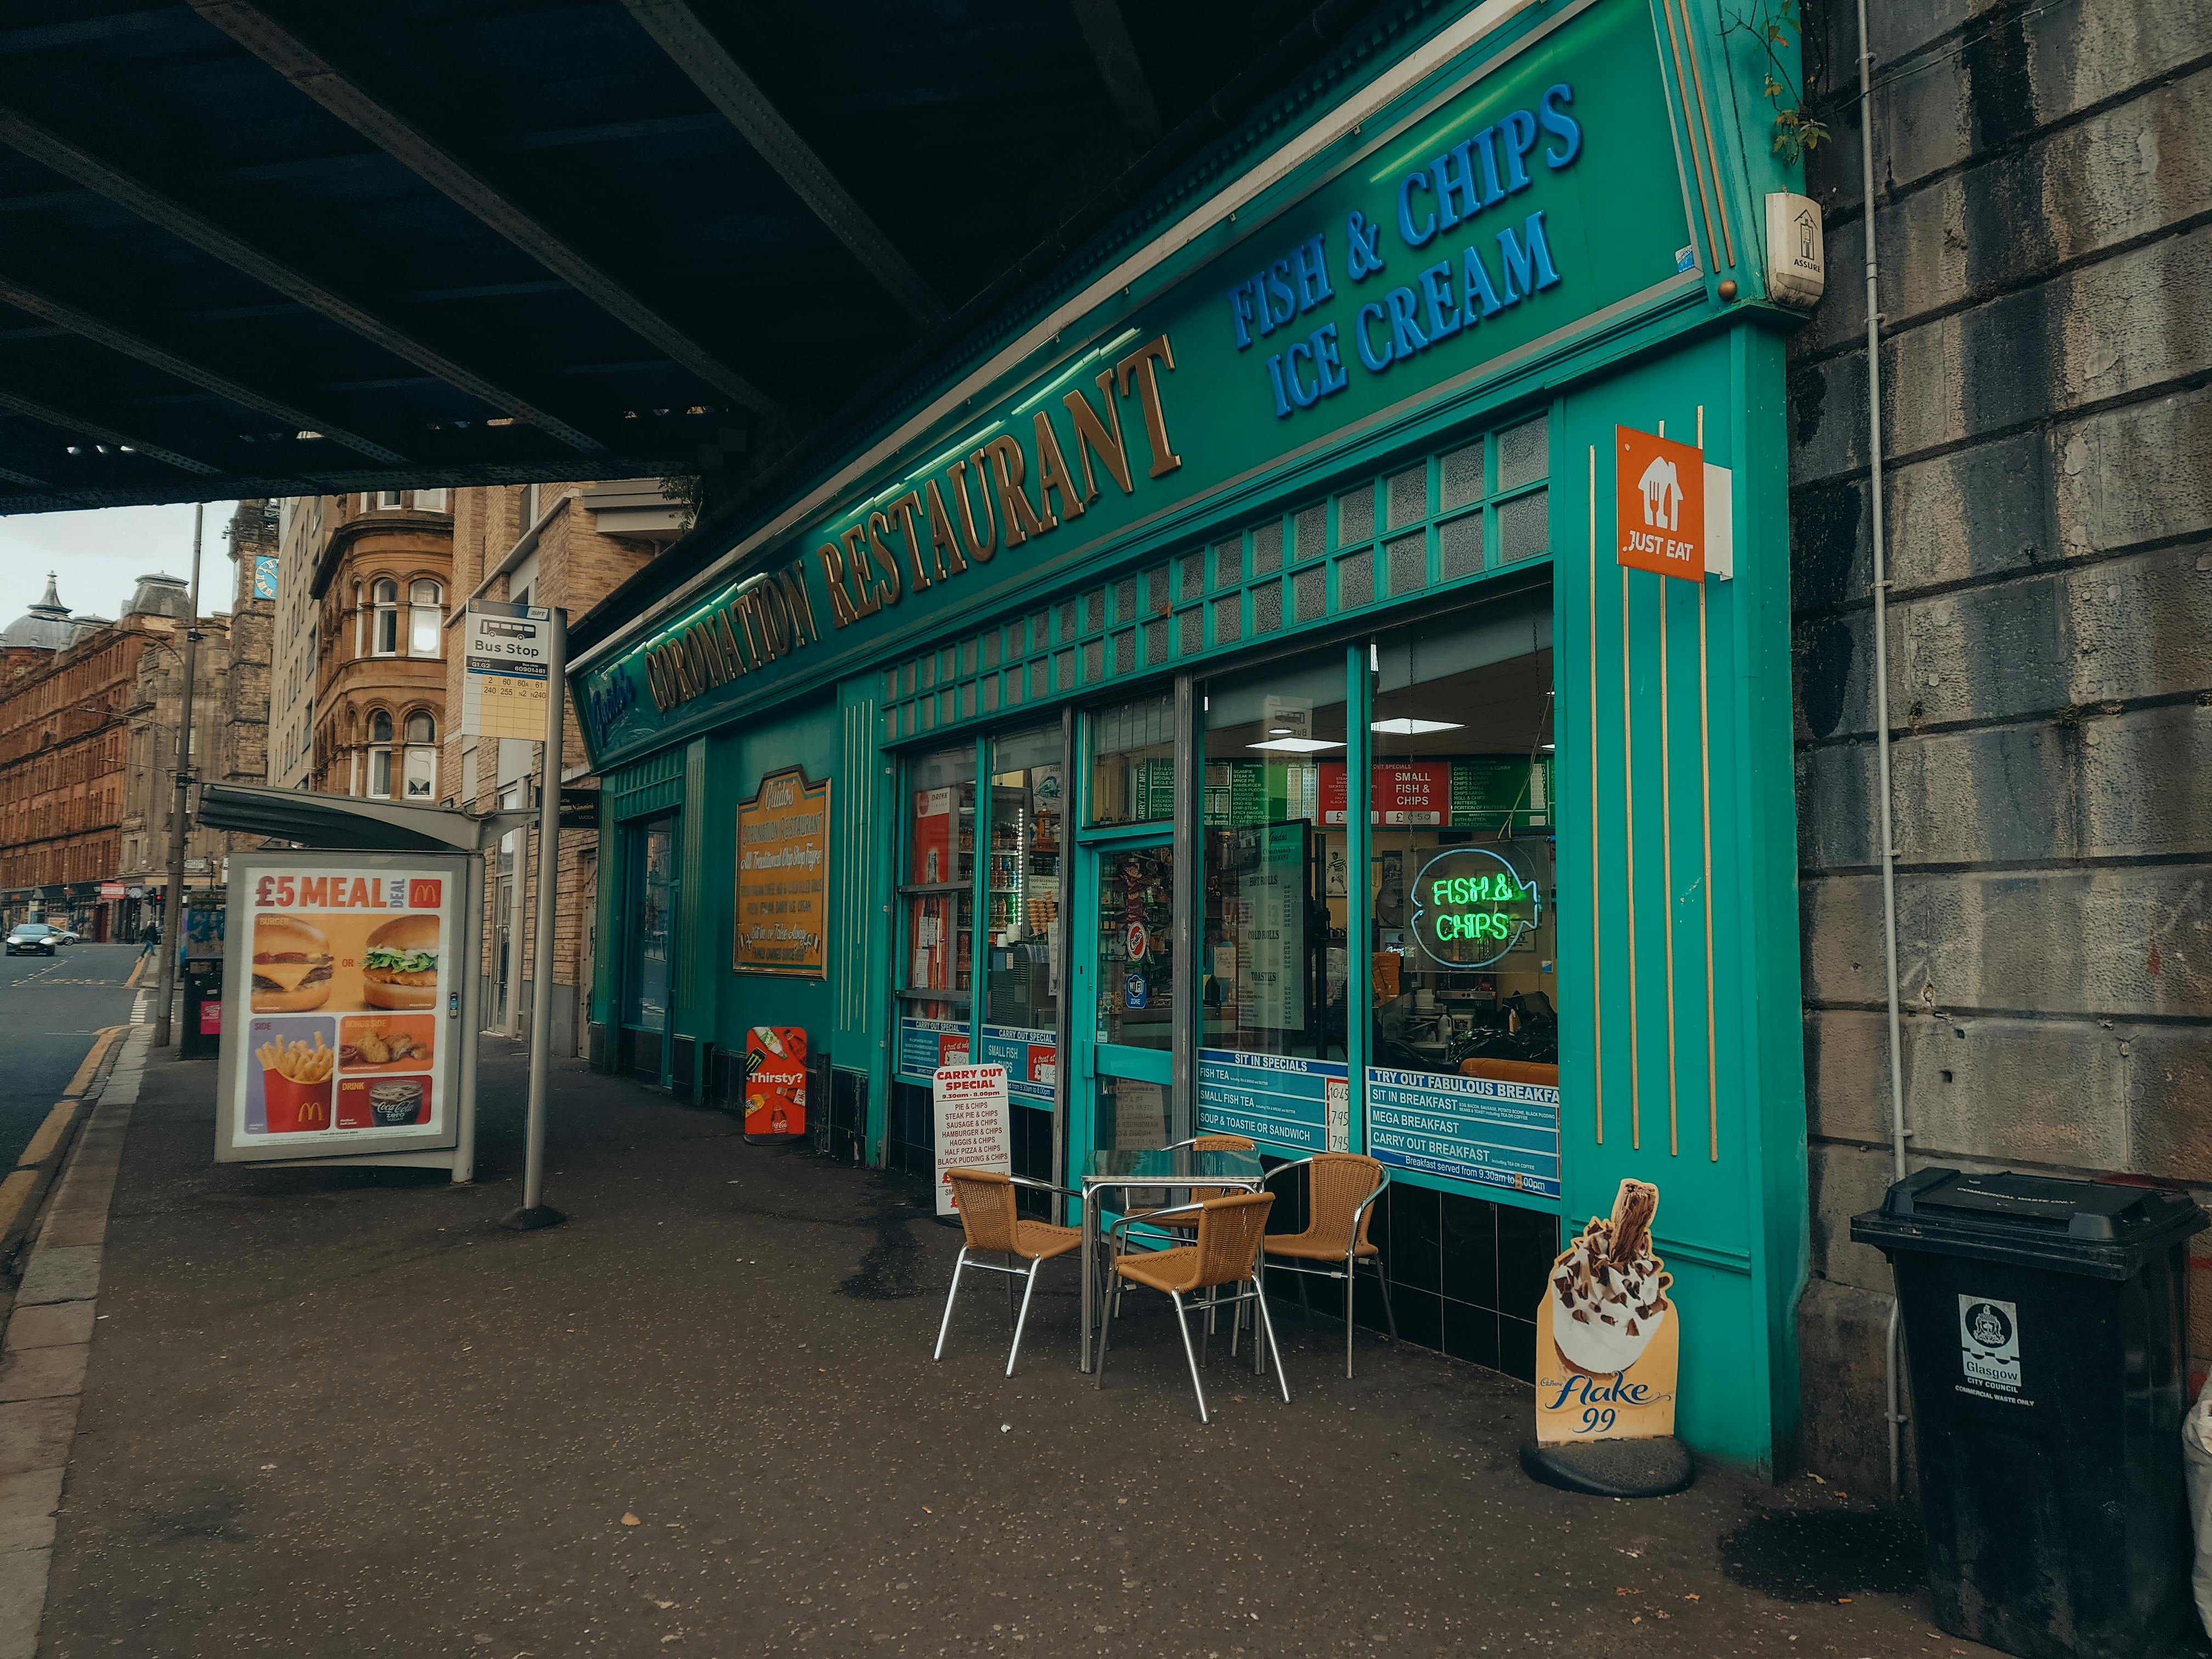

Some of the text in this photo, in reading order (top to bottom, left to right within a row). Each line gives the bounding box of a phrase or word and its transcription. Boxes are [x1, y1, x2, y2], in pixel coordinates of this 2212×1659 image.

[1228, 83, 1581, 349] FISH & CHIPS
[1793, 258, 1821, 273] ASSURE
[1266, 210, 1561, 417] ICE CREAM
[645, 334, 1181, 713] CORONATION RESTAURANT
[1623, 530, 1694, 561] JUST EAT
[475, 640, 539, 658] Bus Stop
[1395, 772, 1431, 781] SMALL
[932, 792, 948, 800] DRINK
[1396, 784, 1430, 793] FISH &
[1396, 797, 1429, 805] CHIPS
[742, 811, 822, 848] CORONATION RESTAURANT
[741, 851, 751, 870] All
[753, 848, 781, 869] Traditional
[1249, 876, 1278, 886] HOT ROLLS
[255, 876, 405, 909] £5 MEAL DEAL
[1434, 873, 1513, 905] FISH &
[259, 917, 289, 926] BURGER
[1436, 913, 1509, 941] CHIPS
[1248, 930, 1279, 940] COLD ROLLS
[342, 958, 354, 967] OR
[1251, 972, 1276, 981] TOASTIES
[255, 1022, 271, 1030] SIDE
[345, 1019, 386, 1028] BONUS SIDE
[940, 1023, 959, 1032] SPECIAL
[998, 1029, 1053, 1043] CARRY OUT SPECIAL
[988, 1045, 1018, 1059] SMALL FISH
[1235, 1053, 1307, 1073] SIT IN SPECIALS
[749, 1072, 803, 1085] Thirsty?
[936, 1068, 1003, 1080] CARRY OUT
[1200, 1068, 1229, 1080] FISH TEA
[341, 1081, 365, 1091] DRINK
[945, 1080, 995, 1091] SPECIAL
[1020, 1084, 1050, 1096] 9.30am 8.00pm
[1375, 1070, 1397, 1084] TRY
[1400, 1073, 1425, 1087] OUT
[1428, 1076, 1493, 1096] FABULOUS
[1200, 1090, 1254, 1108] SMALL FISH TEA
[1373, 1088, 1458, 1111] SIT IN BREAKFAST
[946, 1121, 974, 1129] SAUSAGE
[1200, 1112, 1310, 1142] SOUP & TOASTIE OR SANDWICH
[1373, 1110, 1459, 1134] MEGA BREAKFAST
[942, 1130, 979, 1138] HAMBURGER
[1373, 1132, 1489, 1163] CARRY OUT BREAKFAST
[938, 1157, 957, 1165] BLACK
[1406, 1155, 1436, 1170] Breakfast
[1437, 1163, 1460, 1174] served
[1461, 1166, 1478, 1177] from
[1479, 1170, 1506, 1183] 9.30am
[1507, 1173, 1515, 1184] to
[1967, 1361, 2017, 1380] Glasgow
[1545, 1370, 1671, 1410] flake
[1967, 1377, 2018, 1393] CITY COUNCIL
[1955, 1385, 2034, 1407] COMMERCIAL WASTE ONLY
[1572, 1408, 1616, 1434] 99
